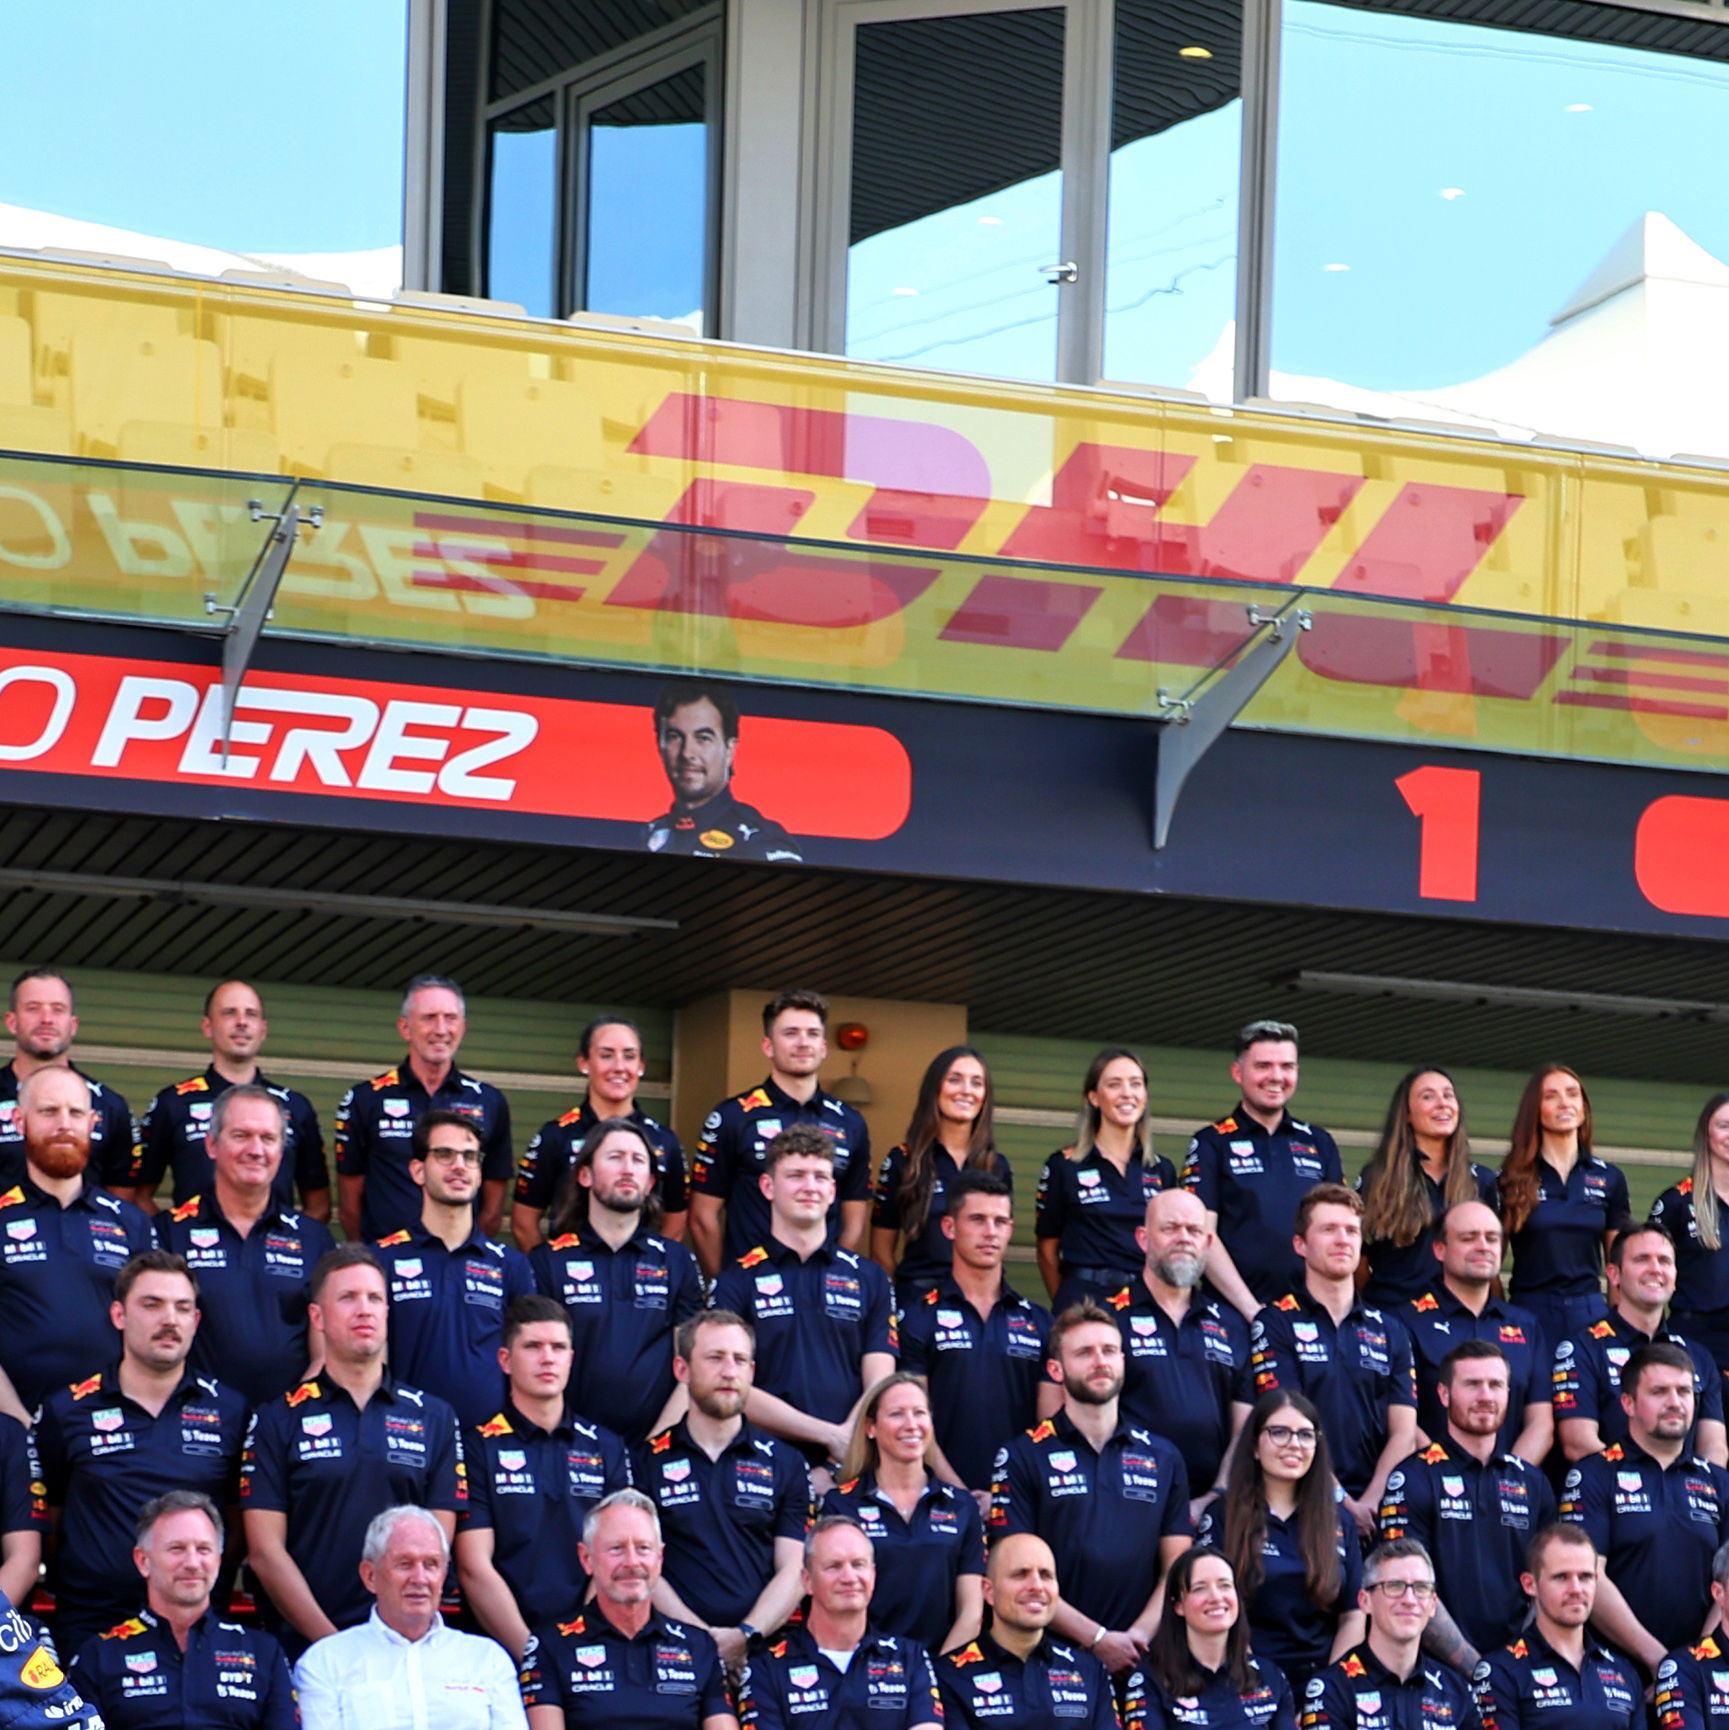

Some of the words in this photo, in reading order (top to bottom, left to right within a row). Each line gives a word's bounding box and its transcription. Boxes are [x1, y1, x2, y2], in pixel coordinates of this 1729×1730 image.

[605, 392, 1573, 702] DHL
[93, 675, 541, 801] PEREZ
[1394, 765, 1480, 902] 1
